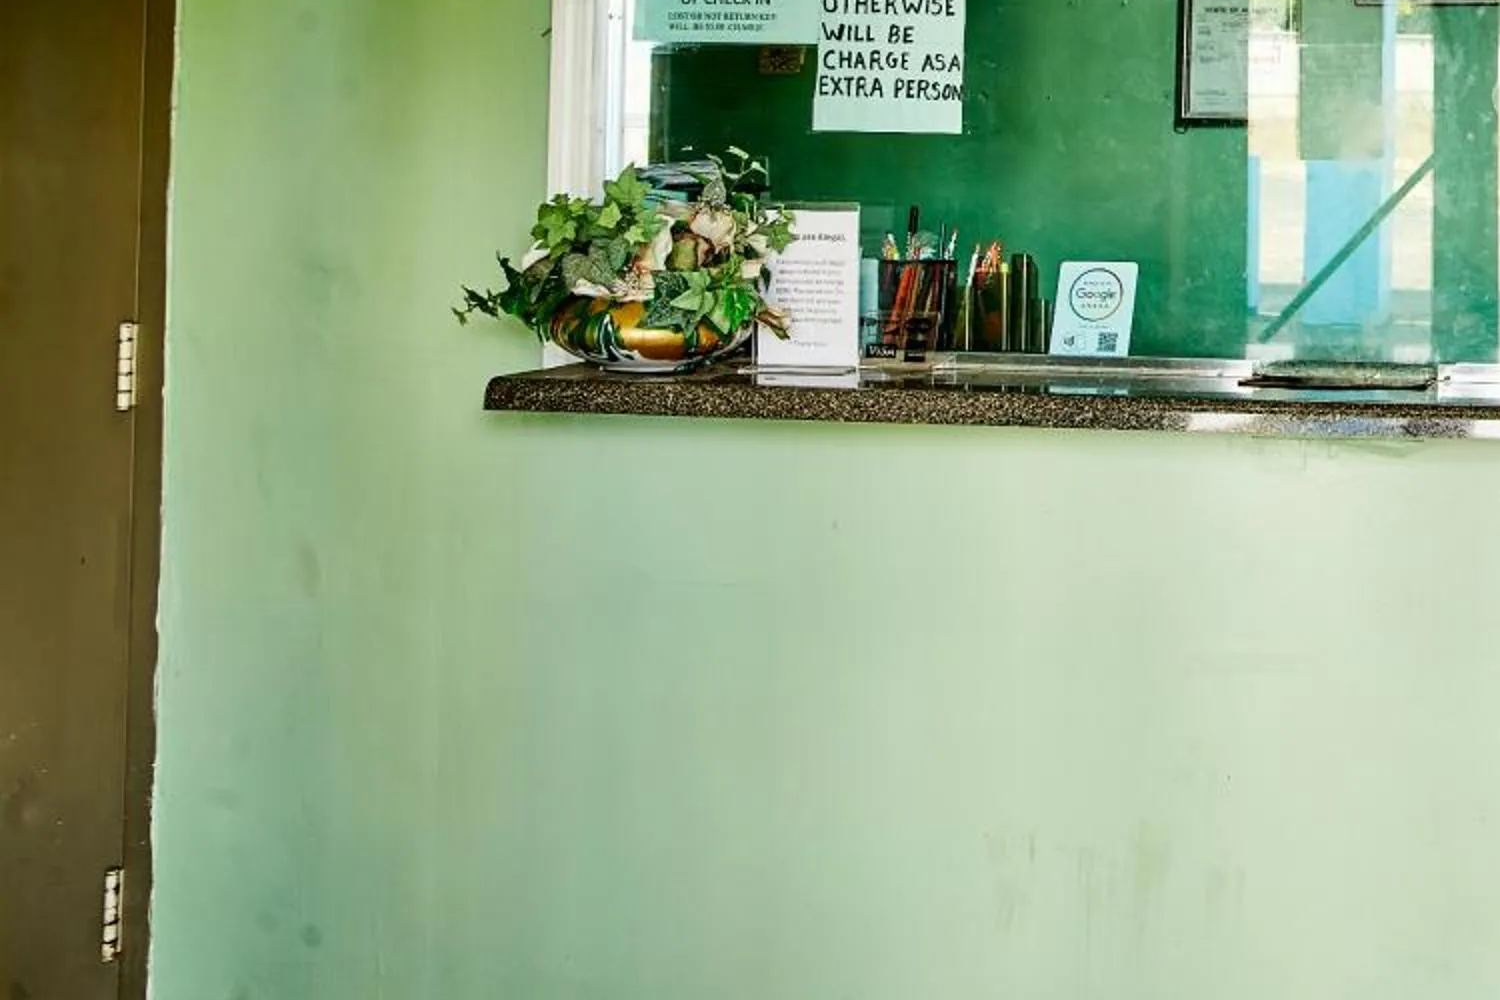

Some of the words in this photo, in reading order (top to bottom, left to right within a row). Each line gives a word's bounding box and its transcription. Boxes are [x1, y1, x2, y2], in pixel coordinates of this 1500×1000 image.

[822, 22, 875, 42] WILL
[887, 24, 915, 44] BE
[823, 50, 909, 71] CHARGE
[819, 76, 884, 98] EXTRA
[893, 79, 965, 101] PERSON
[1075, 286, 1117, 302] Google
